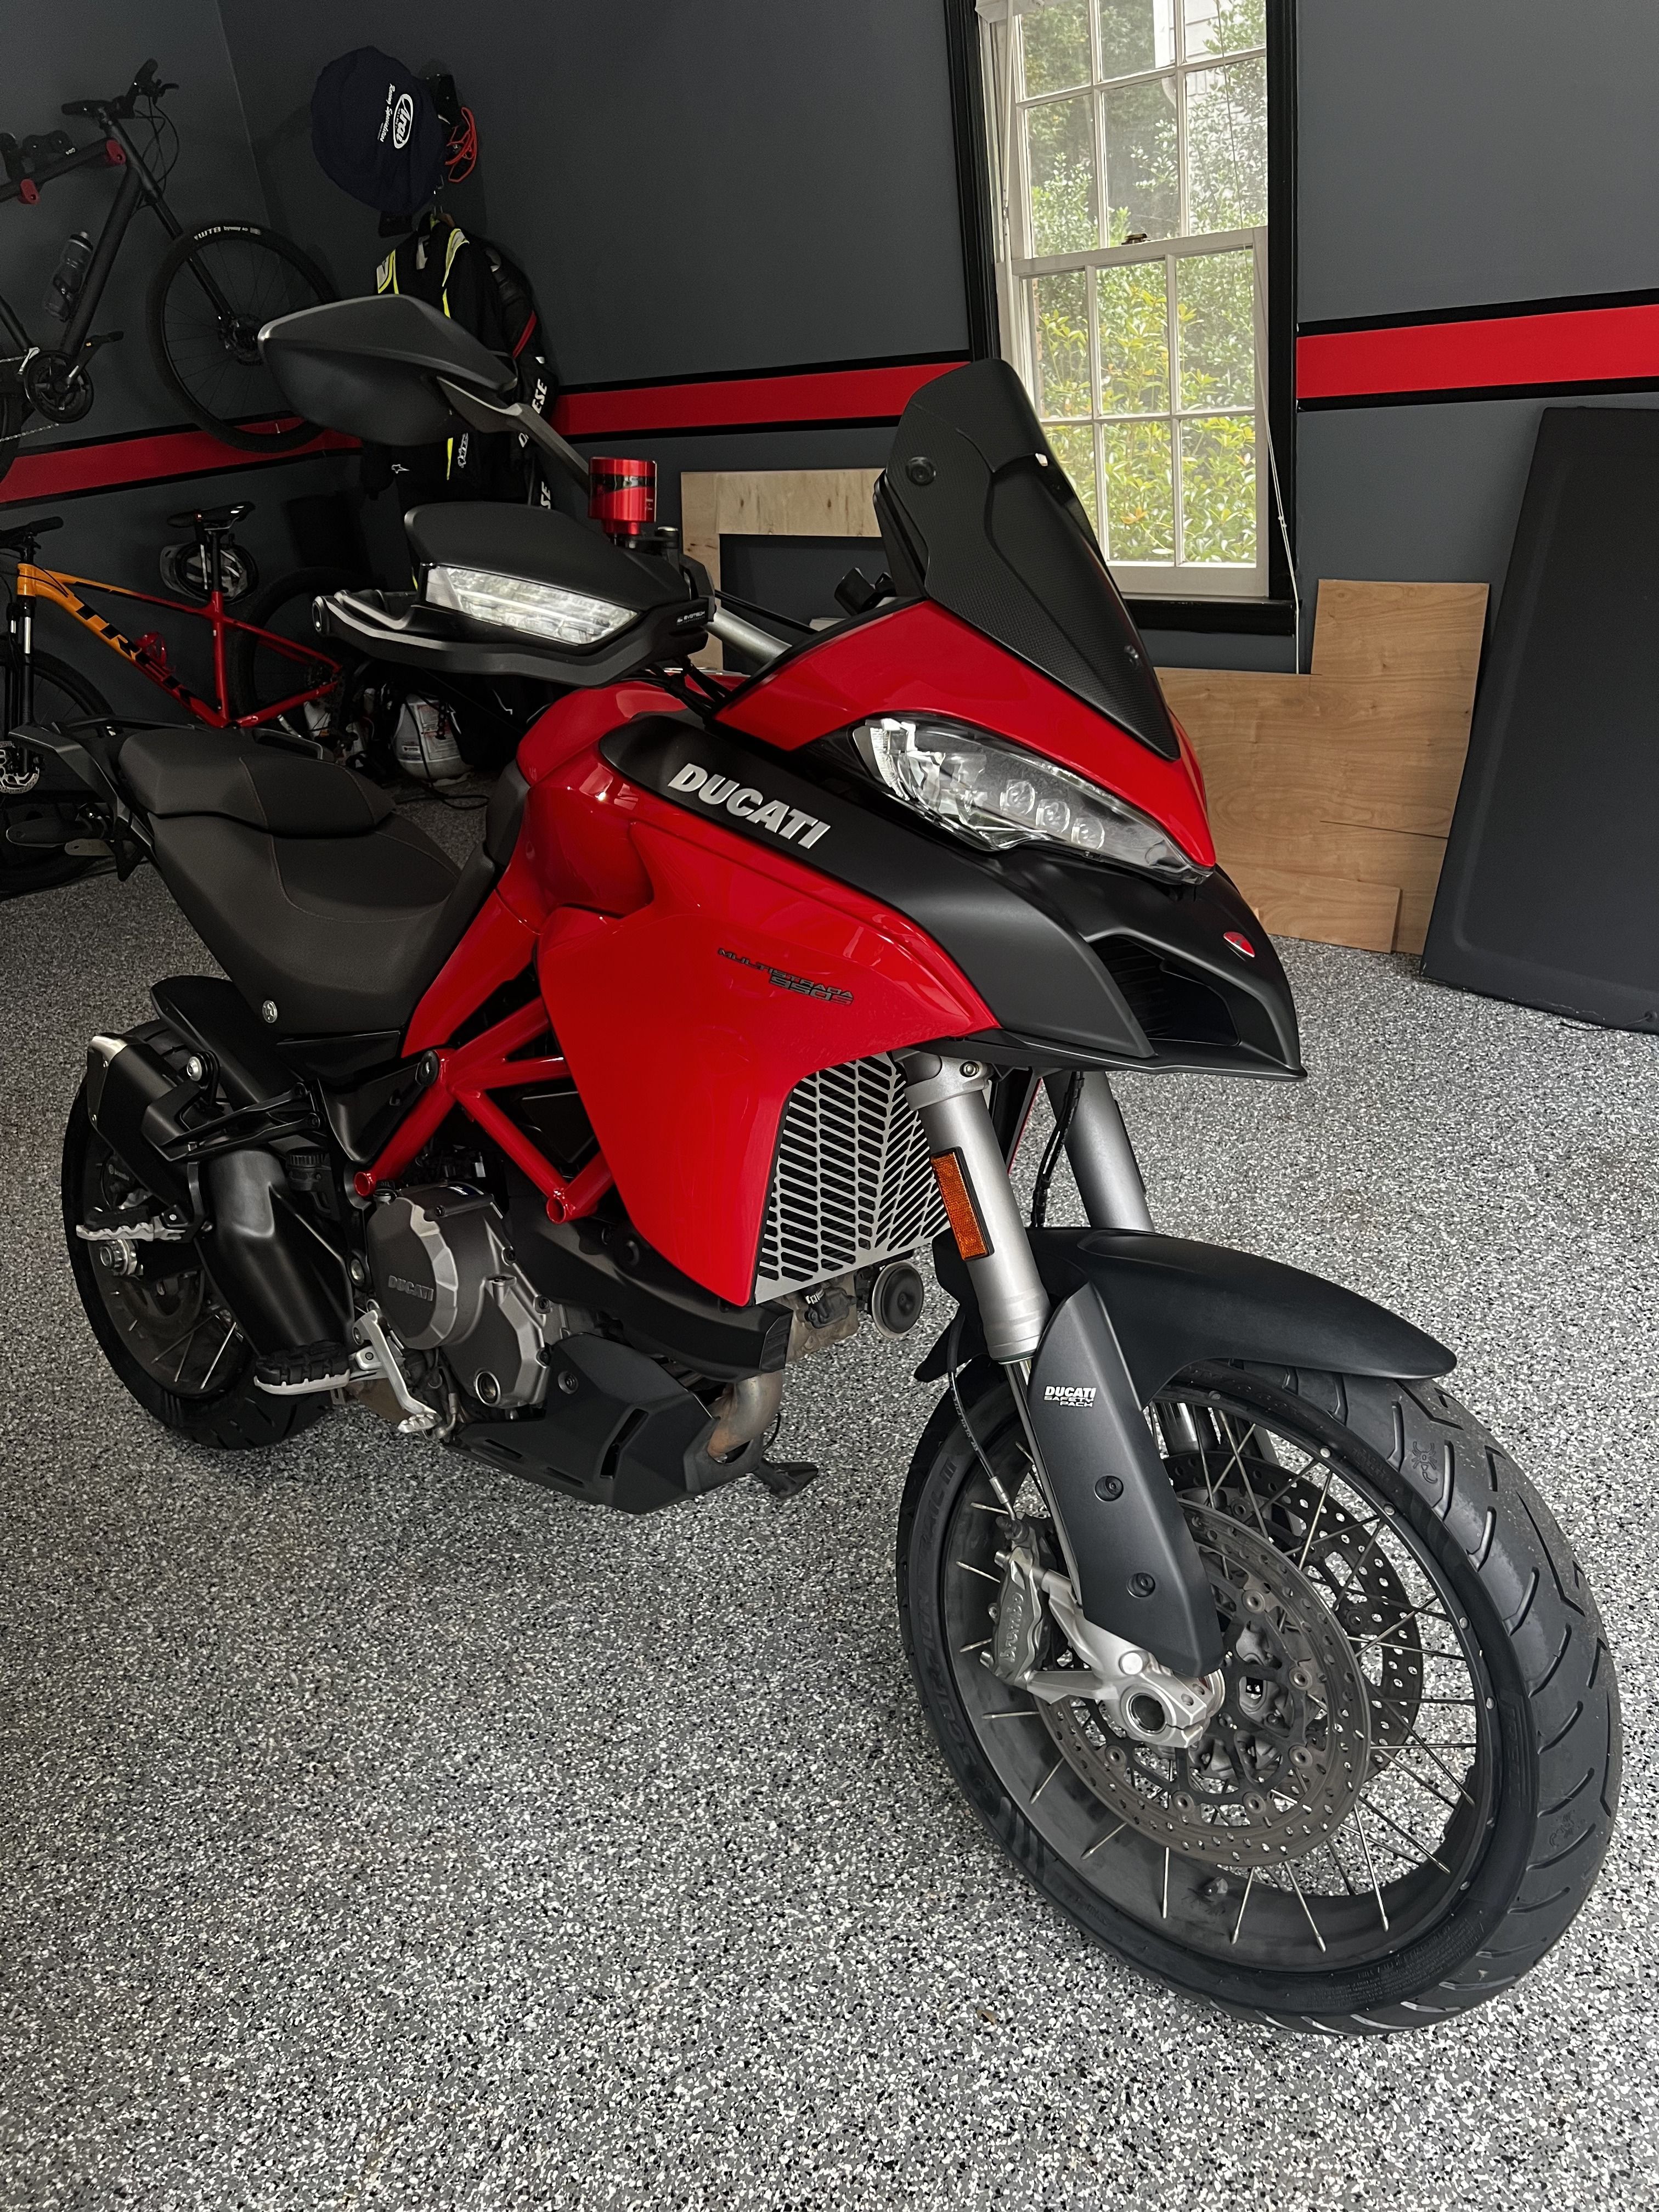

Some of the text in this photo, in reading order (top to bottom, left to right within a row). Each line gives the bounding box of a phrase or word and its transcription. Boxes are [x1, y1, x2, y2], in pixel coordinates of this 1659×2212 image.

[396, 95, 411, 144] Arai
[198, 227, 221, 239] WTB
[667, 763, 831, 849] DUCATI
[718, 948, 854, 998] MULTISTRADA
[388, 1275, 434, 1301] DUCATI
[1045, 1386, 1097, 1398] DUCATI
[1000, 1592, 1024, 1663] brembo
